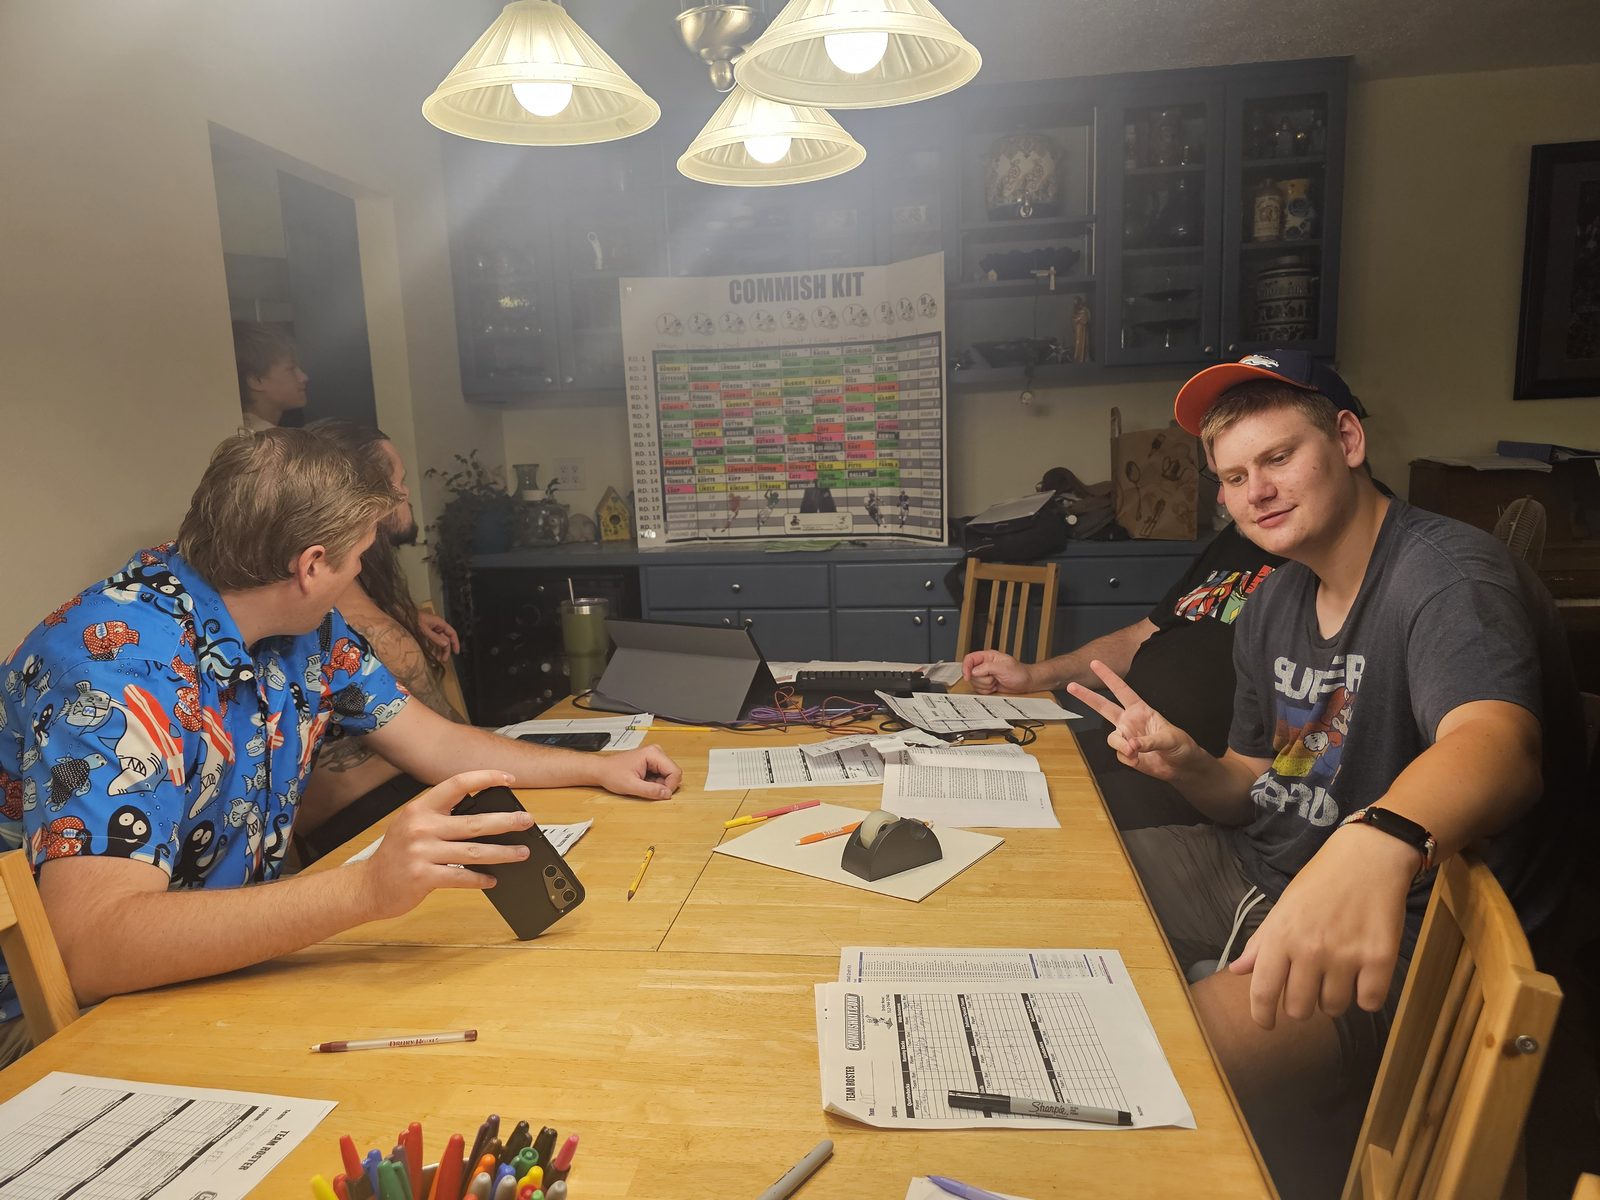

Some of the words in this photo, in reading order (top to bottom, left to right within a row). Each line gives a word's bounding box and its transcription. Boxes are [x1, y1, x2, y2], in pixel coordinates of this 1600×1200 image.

[729, 274, 827, 305] COMMISH
[831, 271, 865, 299] KIT
[847, 996, 860, 1050] COMMISHKIT.COM
[845, 1065, 856, 1087] ROSTER
[846, 1086, 856, 1102] TEAM
[1028, 1101, 1067, 1116] Sharpie
[265, 1129, 290, 1147] TEAM
[238, 1145, 272, 1171] ROSTER
